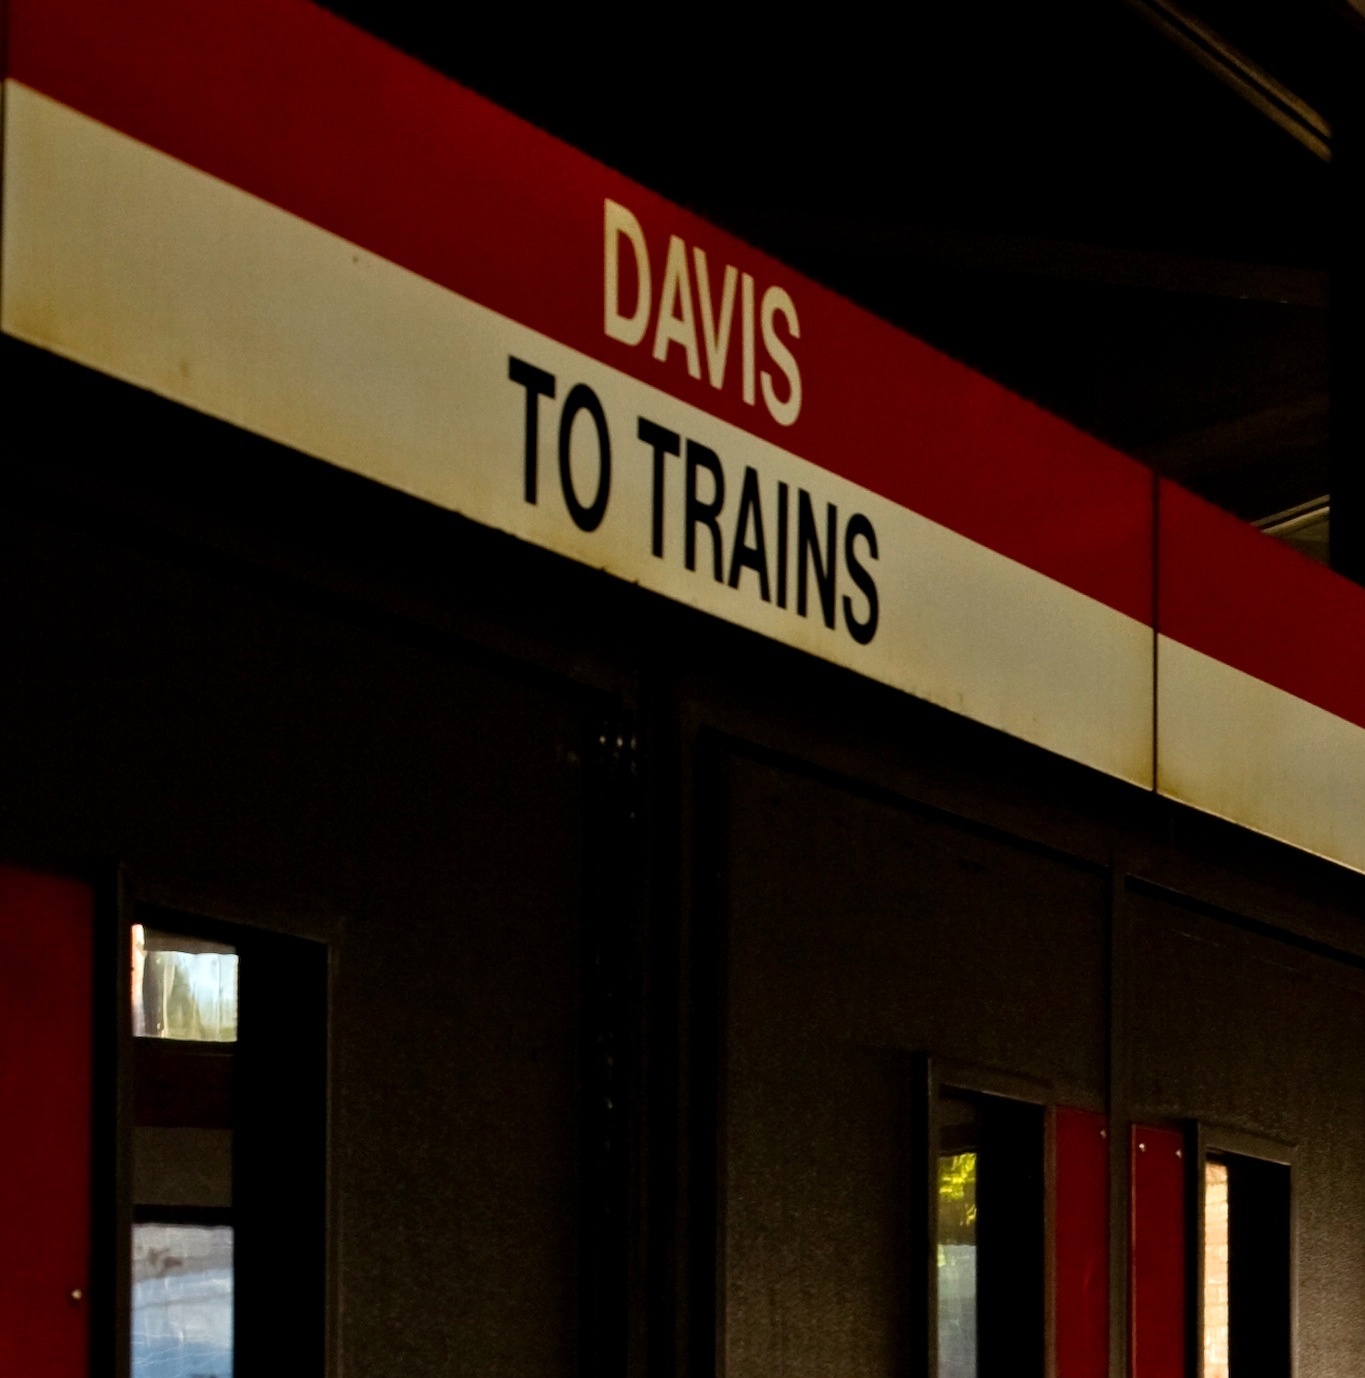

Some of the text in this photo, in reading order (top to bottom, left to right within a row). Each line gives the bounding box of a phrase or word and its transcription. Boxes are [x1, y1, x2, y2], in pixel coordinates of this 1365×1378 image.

[604, 198, 802, 426] DAVIS
[508, 354, 879, 645] TO TRAINS
